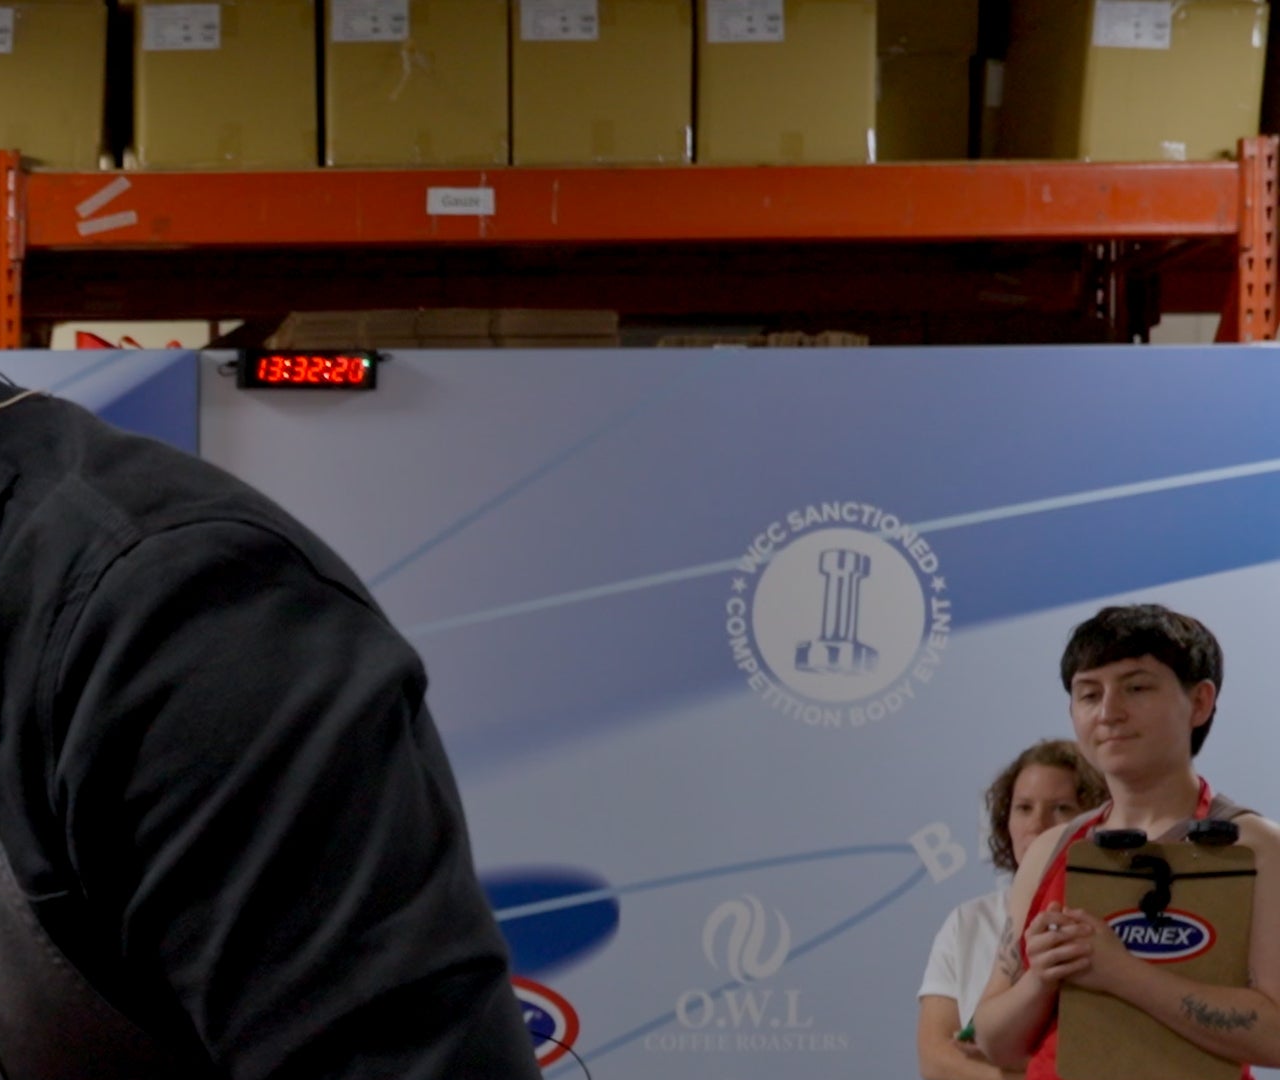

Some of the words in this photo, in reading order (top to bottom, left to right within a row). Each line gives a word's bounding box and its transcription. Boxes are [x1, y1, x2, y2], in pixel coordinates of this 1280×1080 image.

[258, 355, 366, 382] 13:32:20
[738, 520, 788, 575] WCC
[786, 501, 939, 574] SANCTIONED
[726, 596, 841, 728] COMPETITION
[849, 680, 916, 728] BODY
[912, 596, 952, 683] EVENT
[675, 988, 814, 1029] O.W.L
[644, 1032, 728, 1051] COFFEE
[736, 1032, 850, 1051] ROASTERS
